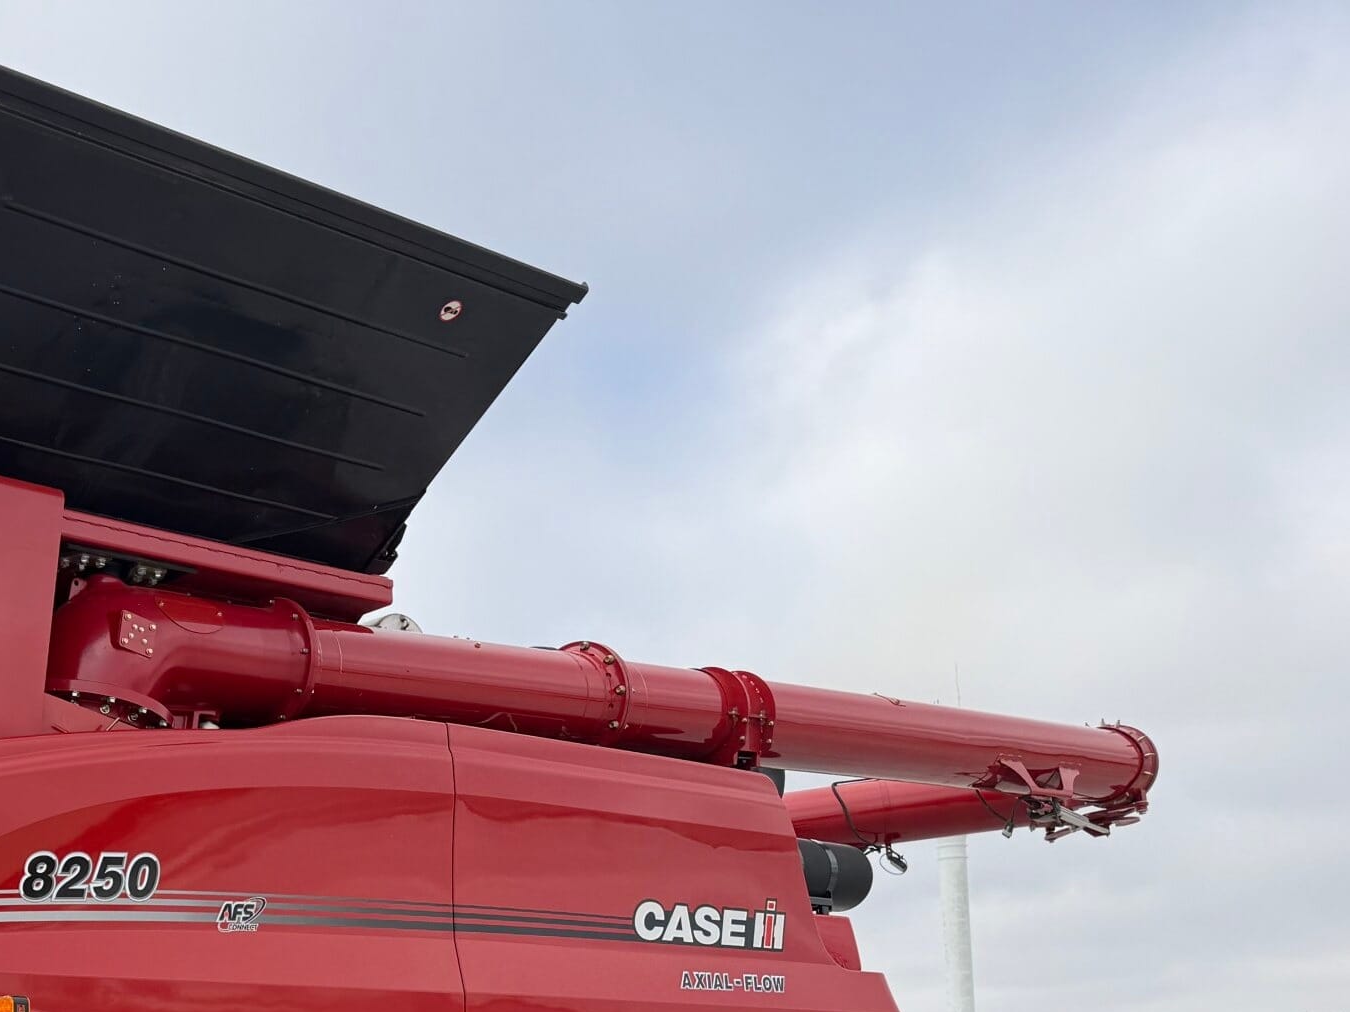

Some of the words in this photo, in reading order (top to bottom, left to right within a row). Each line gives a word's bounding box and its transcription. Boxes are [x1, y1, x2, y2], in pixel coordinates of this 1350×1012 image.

[20, 851, 160, 902] 8250
[217, 901, 256, 922] AFS
[634, 900, 747, 947] CASE
[681, 971, 785, 993] AXIAL-FLOW
